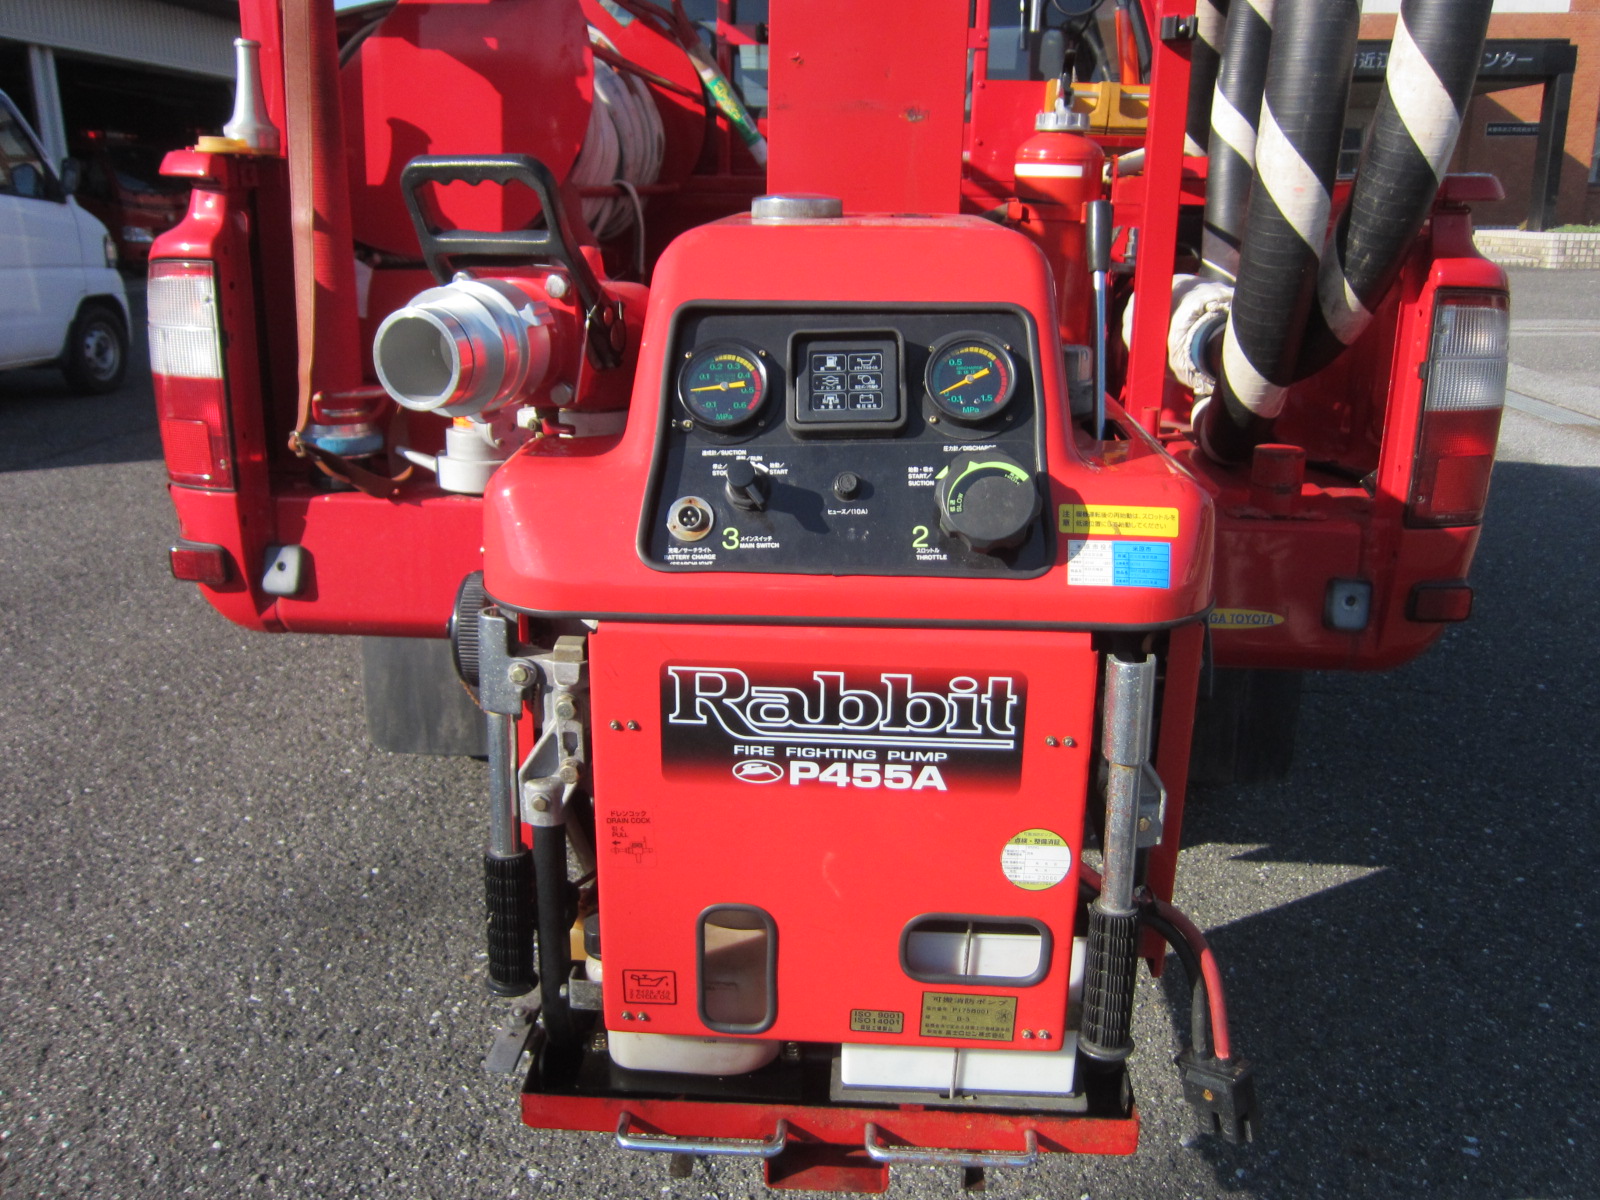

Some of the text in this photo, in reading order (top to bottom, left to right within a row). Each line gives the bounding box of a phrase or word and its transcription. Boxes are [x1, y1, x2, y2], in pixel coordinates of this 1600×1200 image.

[741, 386, 754, 394] 0.5
[981, 394, 993, 402] 1.5
[956, 492, 964, 512] SLOW
[722, 527, 740, 550] 3
[912, 525, 928, 547] 2
[1230, 614, 1274, 624] TOYOTA
[668, 666, 1018, 749] Rabbit
[733, 745, 947, 762] FIRE FIGHTING PUMP
[790, 761, 947, 790] P455A
